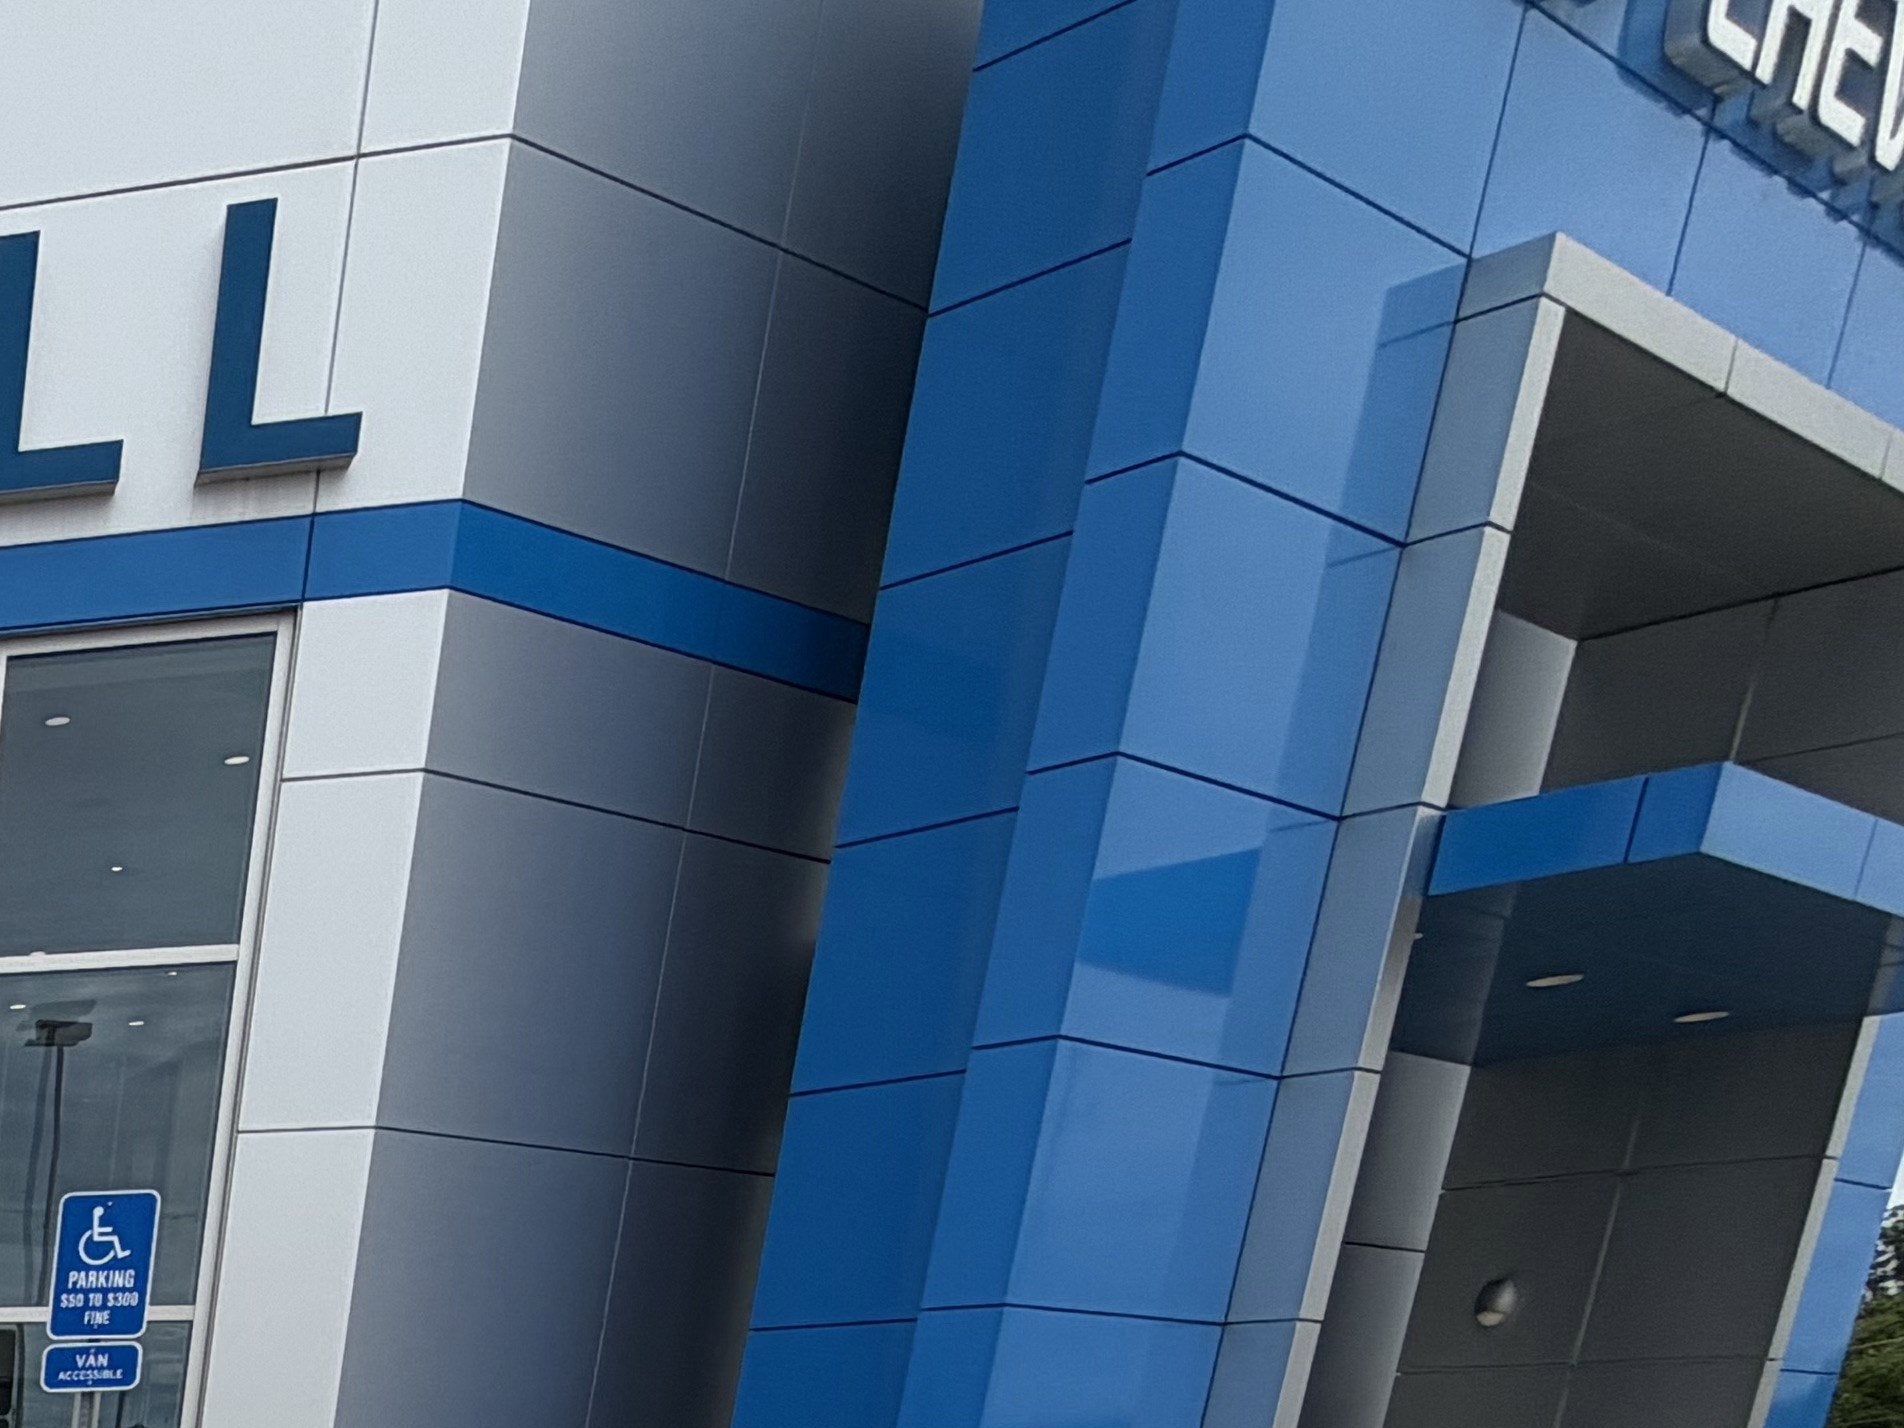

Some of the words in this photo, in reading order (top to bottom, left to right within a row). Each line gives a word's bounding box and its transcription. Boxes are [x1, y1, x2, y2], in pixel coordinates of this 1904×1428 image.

[68, 1268, 135, 1289] PARKING
[60, 1293, 84, 1308] $50
[88, 1292, 103, 1307] TO
[107, 1291, 139, 1308] $300
[84, 1309, 110, 1325] FINE
[75, 1353, 108, 1368] VAN
[57, 1368, 123, 1381] ACCESSIBLE
